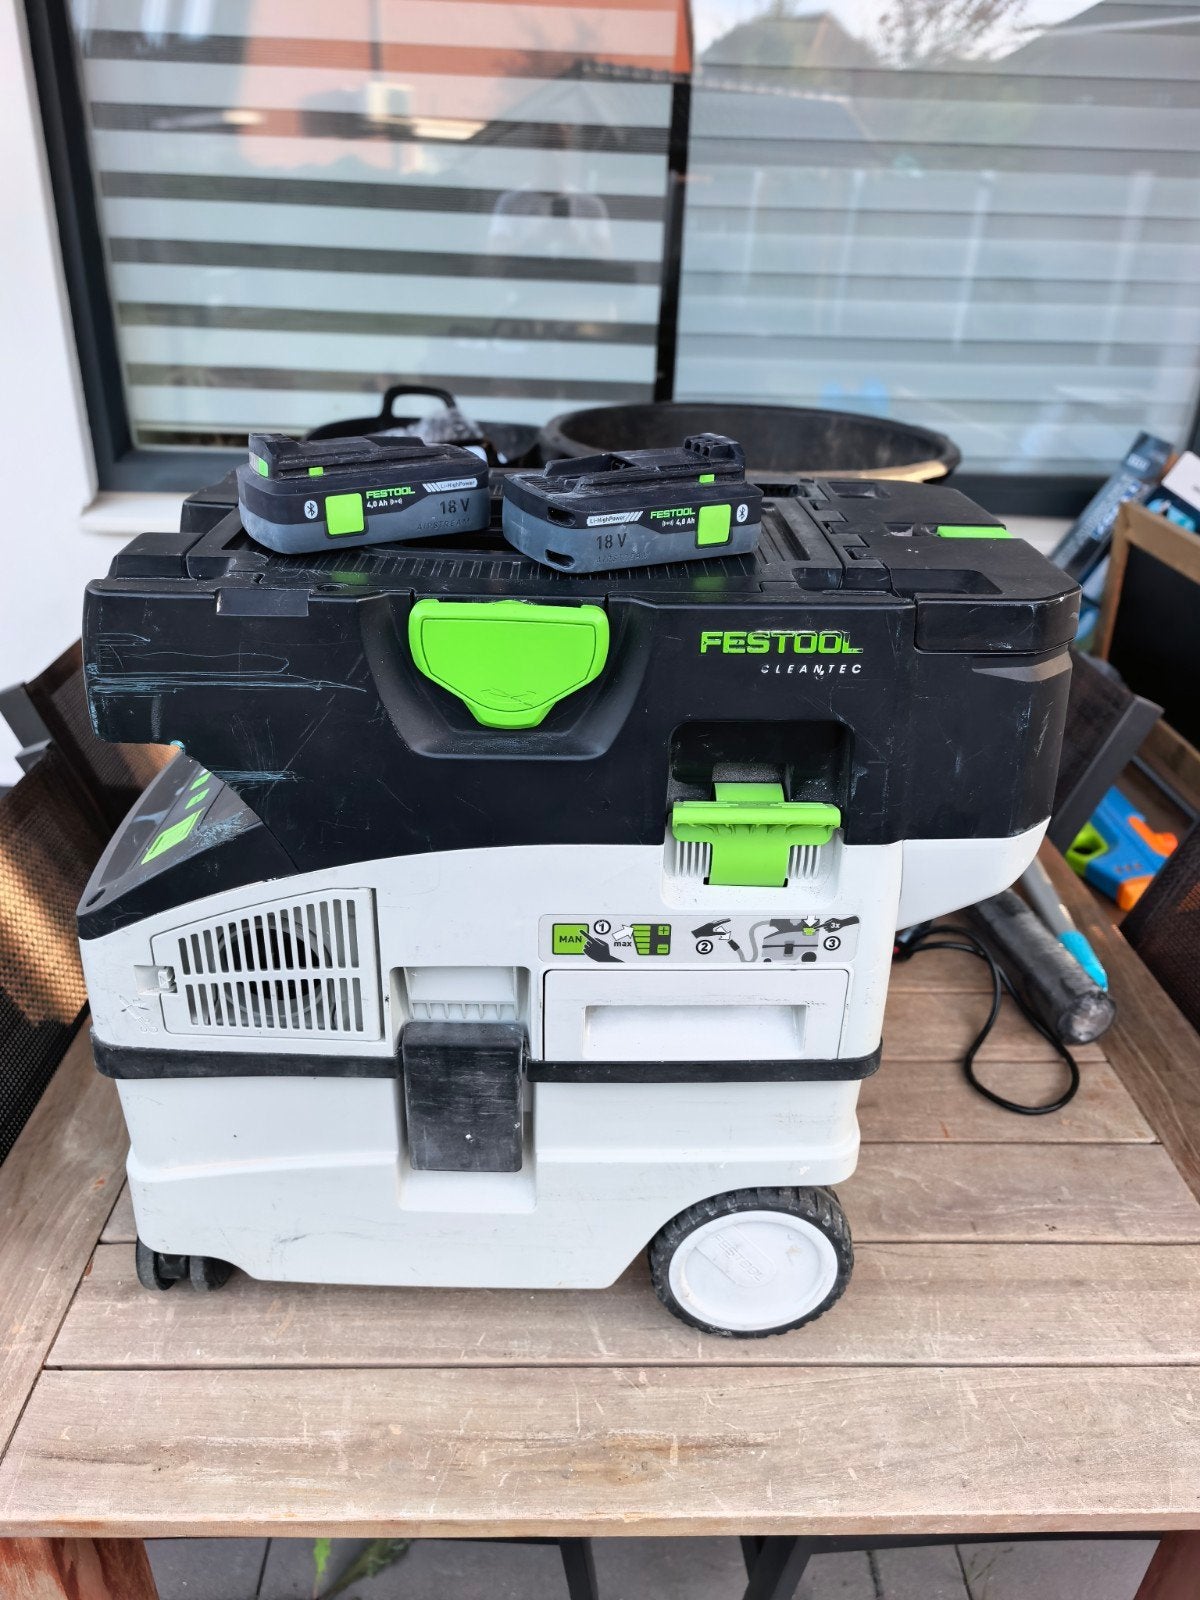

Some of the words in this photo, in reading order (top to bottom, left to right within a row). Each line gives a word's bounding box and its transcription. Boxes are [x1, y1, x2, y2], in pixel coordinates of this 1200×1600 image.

[365, 486, 416, 499] FESTOOL
[378, 499, 388, 507] Ah
[440, 500, 457, 515] 18
[461, 497, 470, 513] V
[650, 507, 696, 520] FESTOOL
[686, 517, 696, 525] Ah
[596, 534, 613, 550] 18
[617, 532, 627, 548] V
[700, 630, 864, 655] FESTOOL
[760, 663, 863, 675] CLEANTEC
[830, 922, 841, 930] 3x
[559, 935, 582, 943] MAN
[613, 940, 633, 948] max
